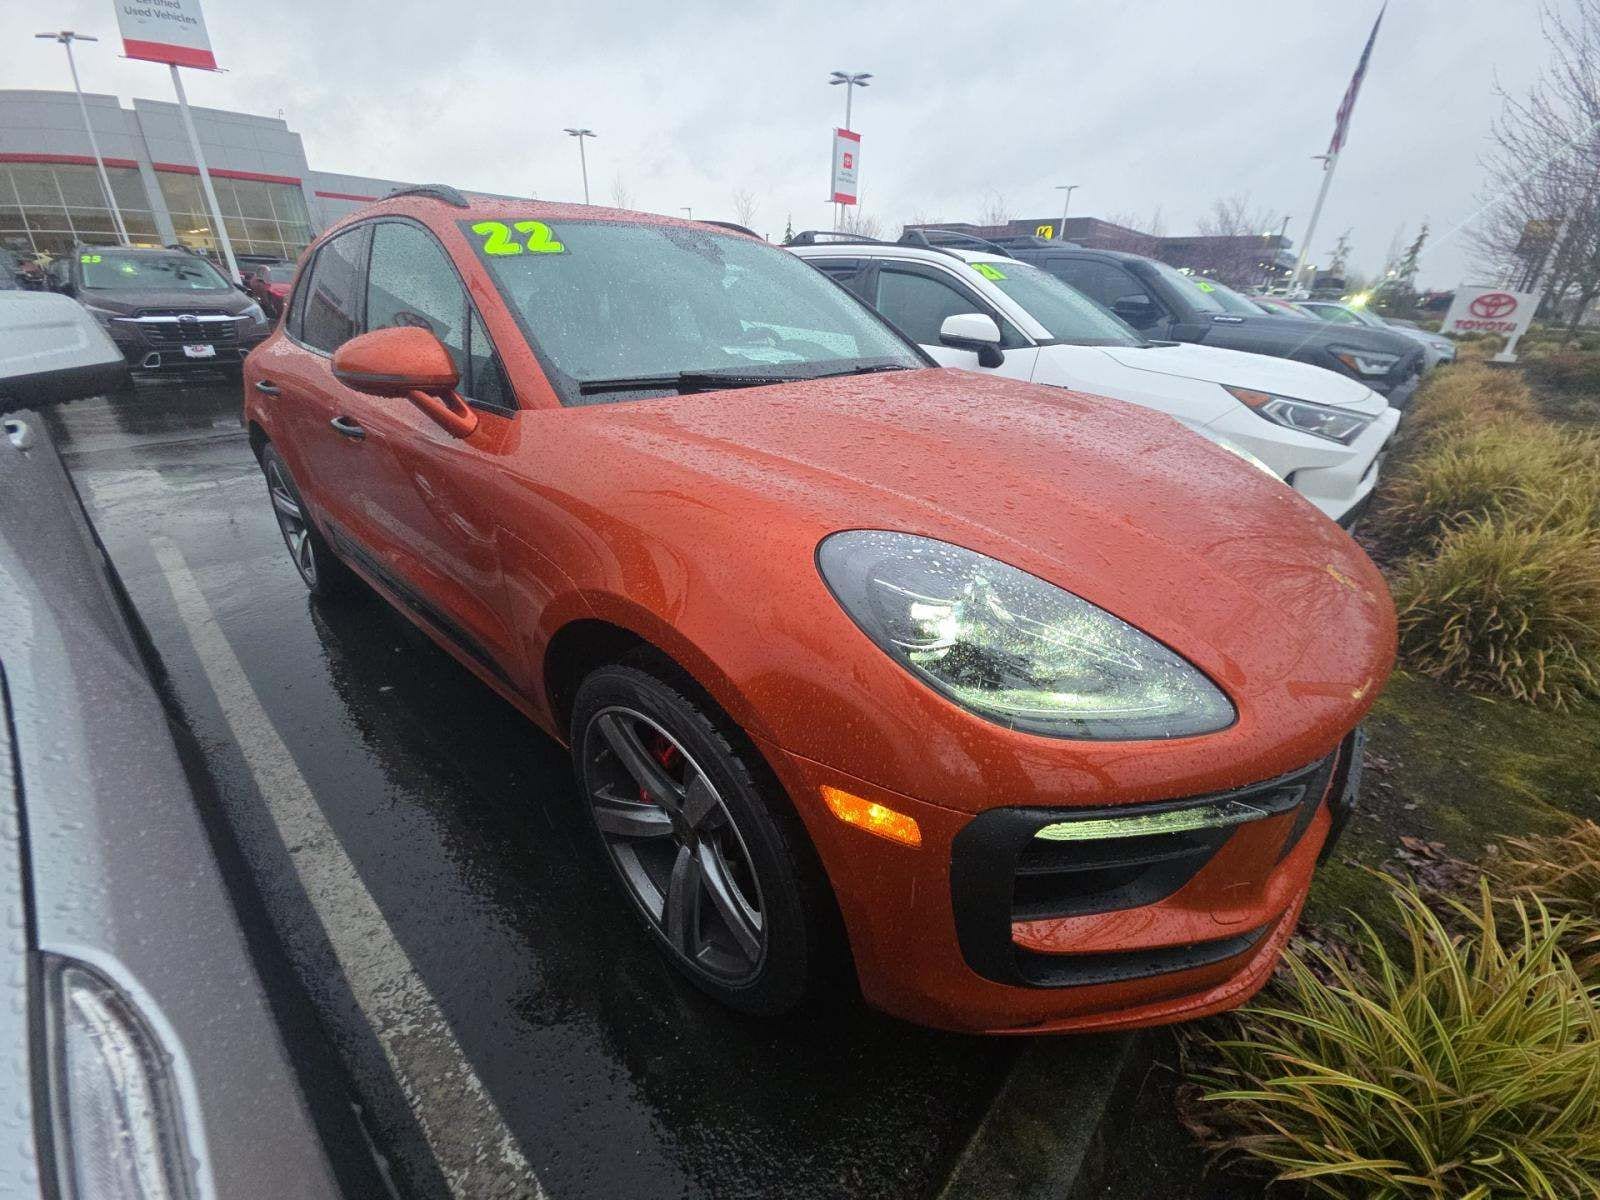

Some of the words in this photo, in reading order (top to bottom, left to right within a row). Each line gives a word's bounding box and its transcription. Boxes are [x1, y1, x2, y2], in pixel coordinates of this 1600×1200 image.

[123, 6, 152, 17] Used
[153, 9, 198, 25] Vehicles
[471, 221, 565, 255] 22
[81, 254, 102, 264] 25
[1455, 320, 1518, 333] TOYOTA
